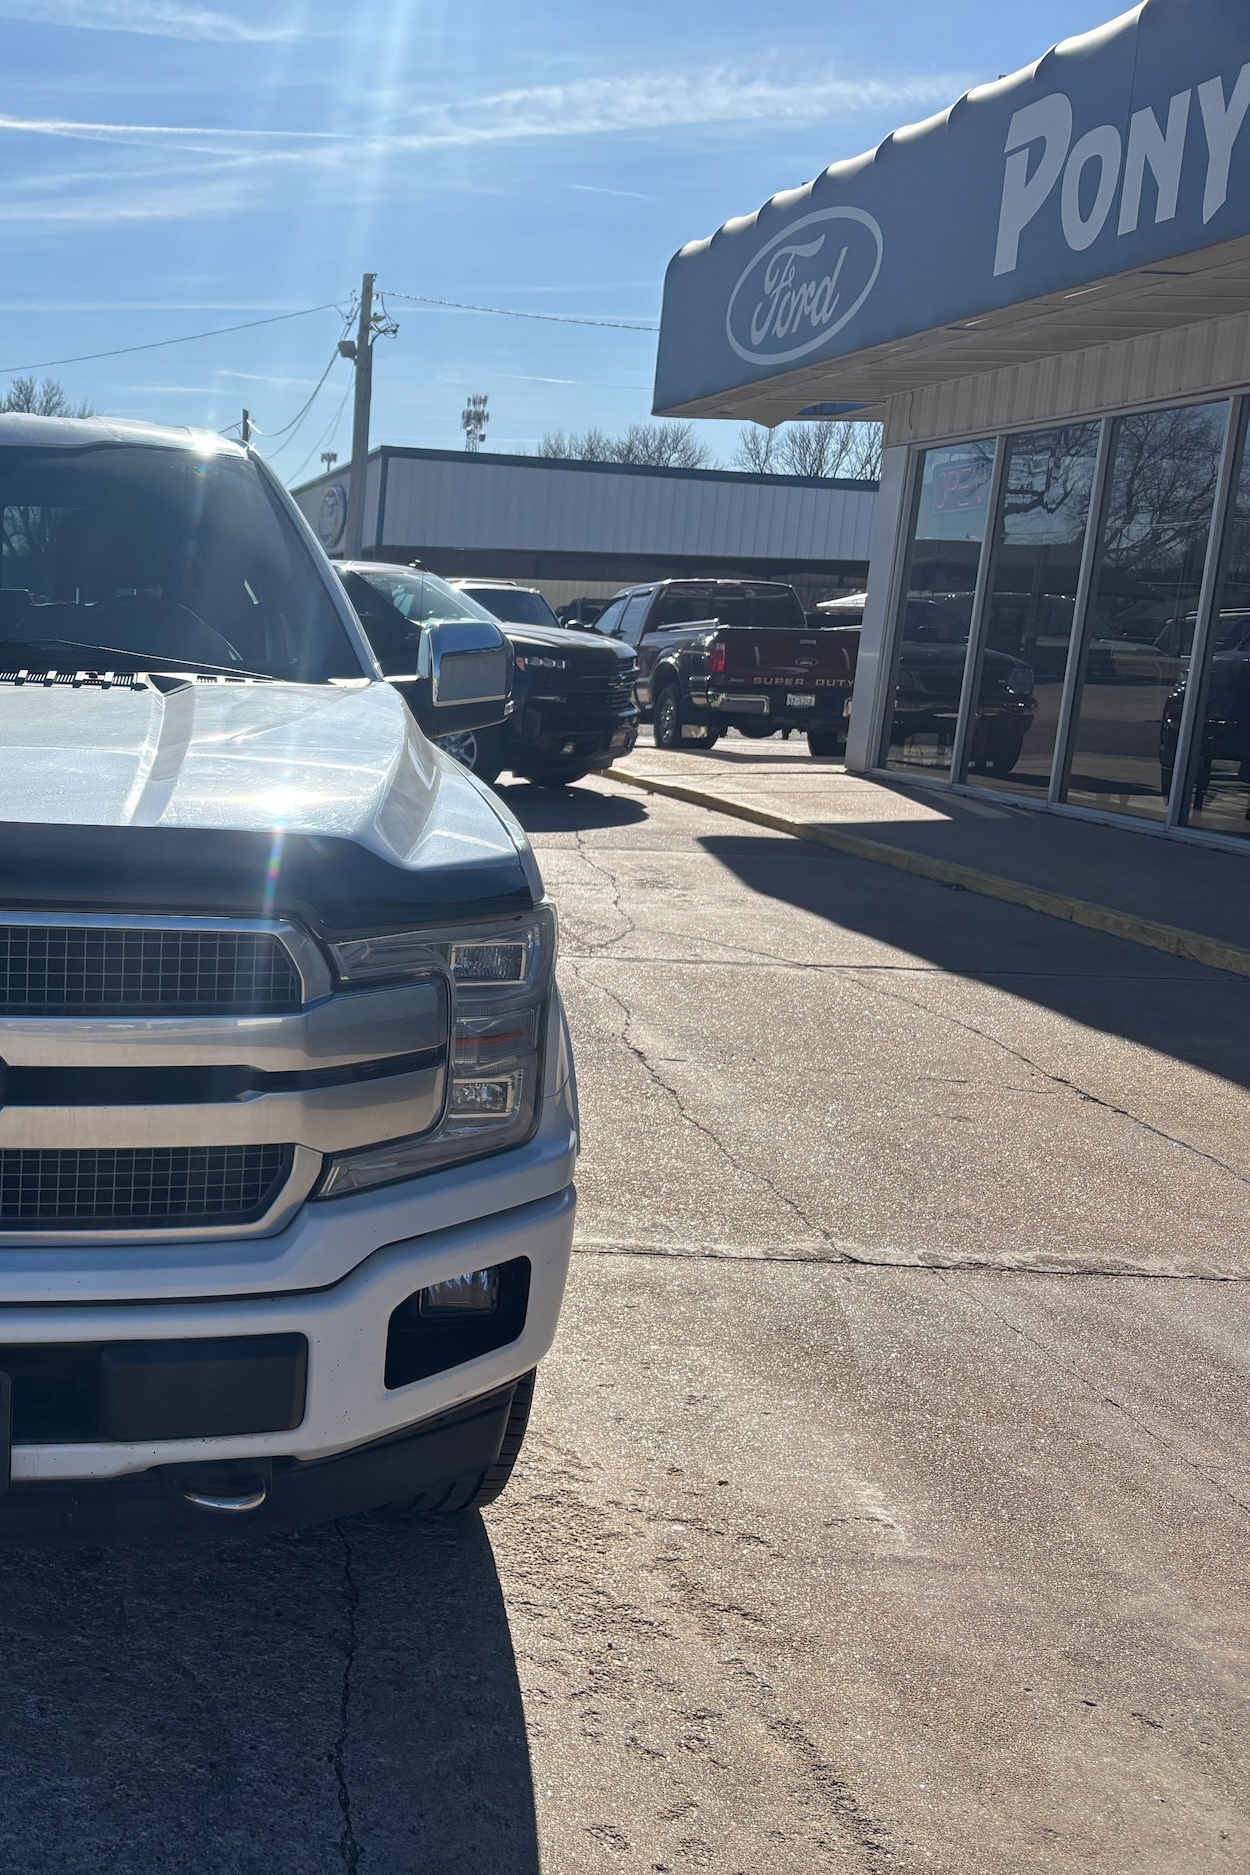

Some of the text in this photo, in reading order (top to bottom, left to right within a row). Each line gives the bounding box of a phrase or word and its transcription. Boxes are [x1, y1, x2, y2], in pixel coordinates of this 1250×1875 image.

[992, 62, 1250, 277] PONY
[750, 233, 848, 345] Ford
[753, 677, 805, 685] SUPER
[815, 678, 854, 687] DUTY
